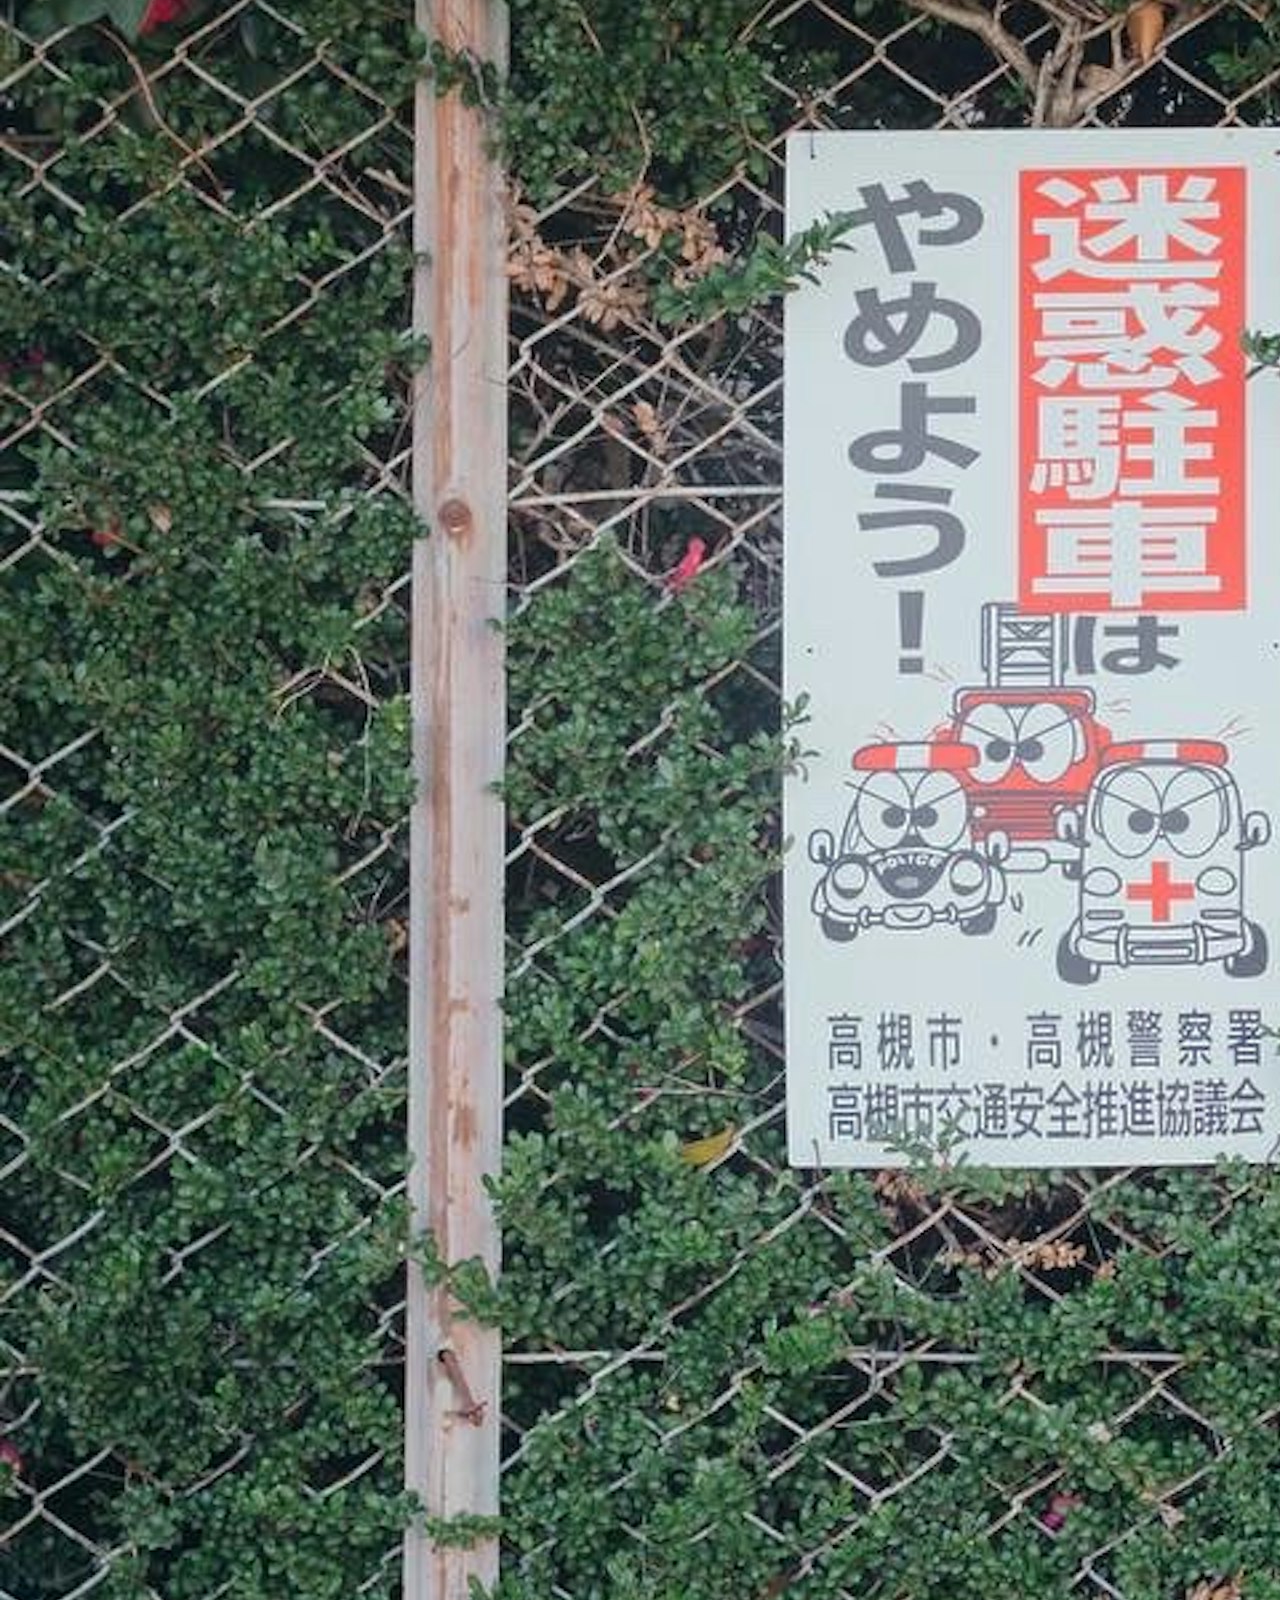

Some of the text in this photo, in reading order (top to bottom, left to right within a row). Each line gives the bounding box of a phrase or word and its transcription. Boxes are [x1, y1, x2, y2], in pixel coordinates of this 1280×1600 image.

[1029, 174, 1222, 676] 迷惑駐車は
[826, 1009, 1262, 1072] 高槻市・高槻警察署
[826, 1077, 1266, 1142] 高槻市交通安全推進協議会
